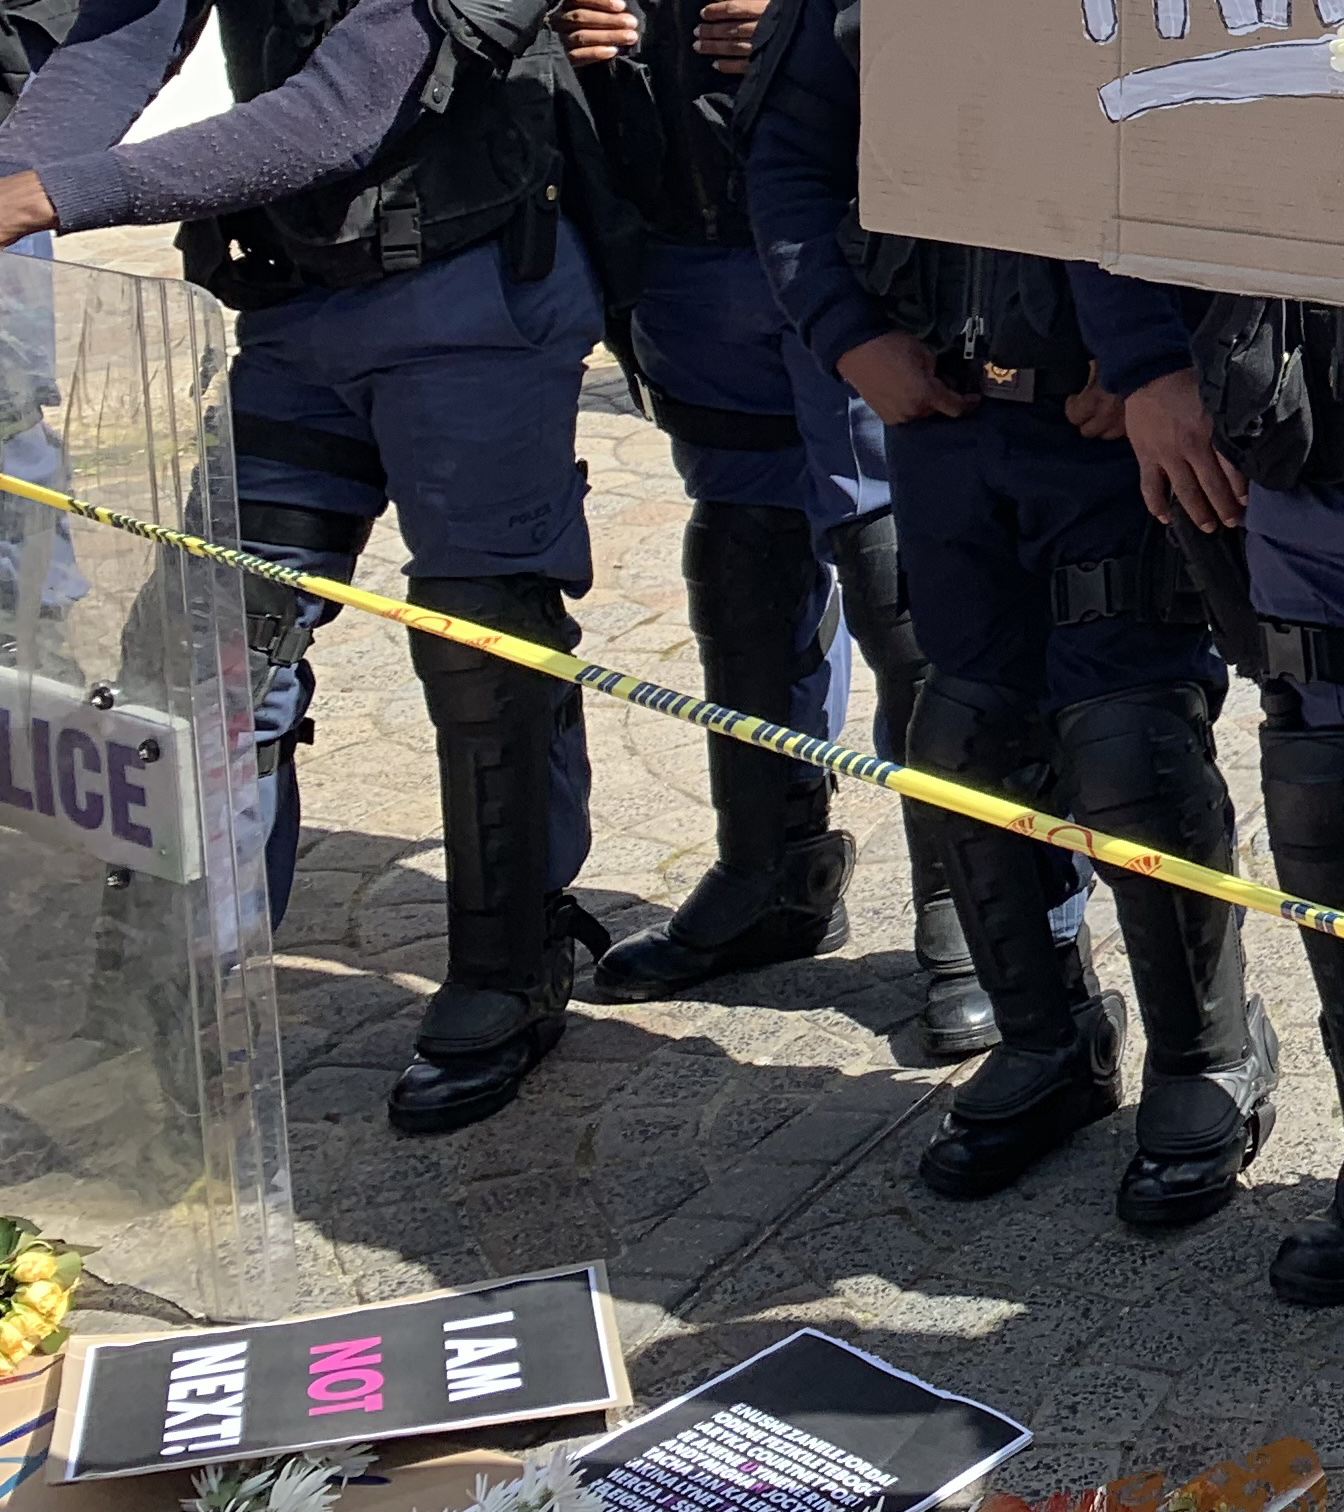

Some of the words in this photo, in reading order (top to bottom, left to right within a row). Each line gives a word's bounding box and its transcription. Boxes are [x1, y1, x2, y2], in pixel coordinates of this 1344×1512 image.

[442, 1311, 515, 1332] I
[307, 1336, 385, 1417] NOT
[444, 1338, 523, 1402] AM
[160, 1340, 248, 1456] NEXT!
[692, 1421, 751, 1451] ARYKA
[758, 1489, 811, 1512] JOCY
